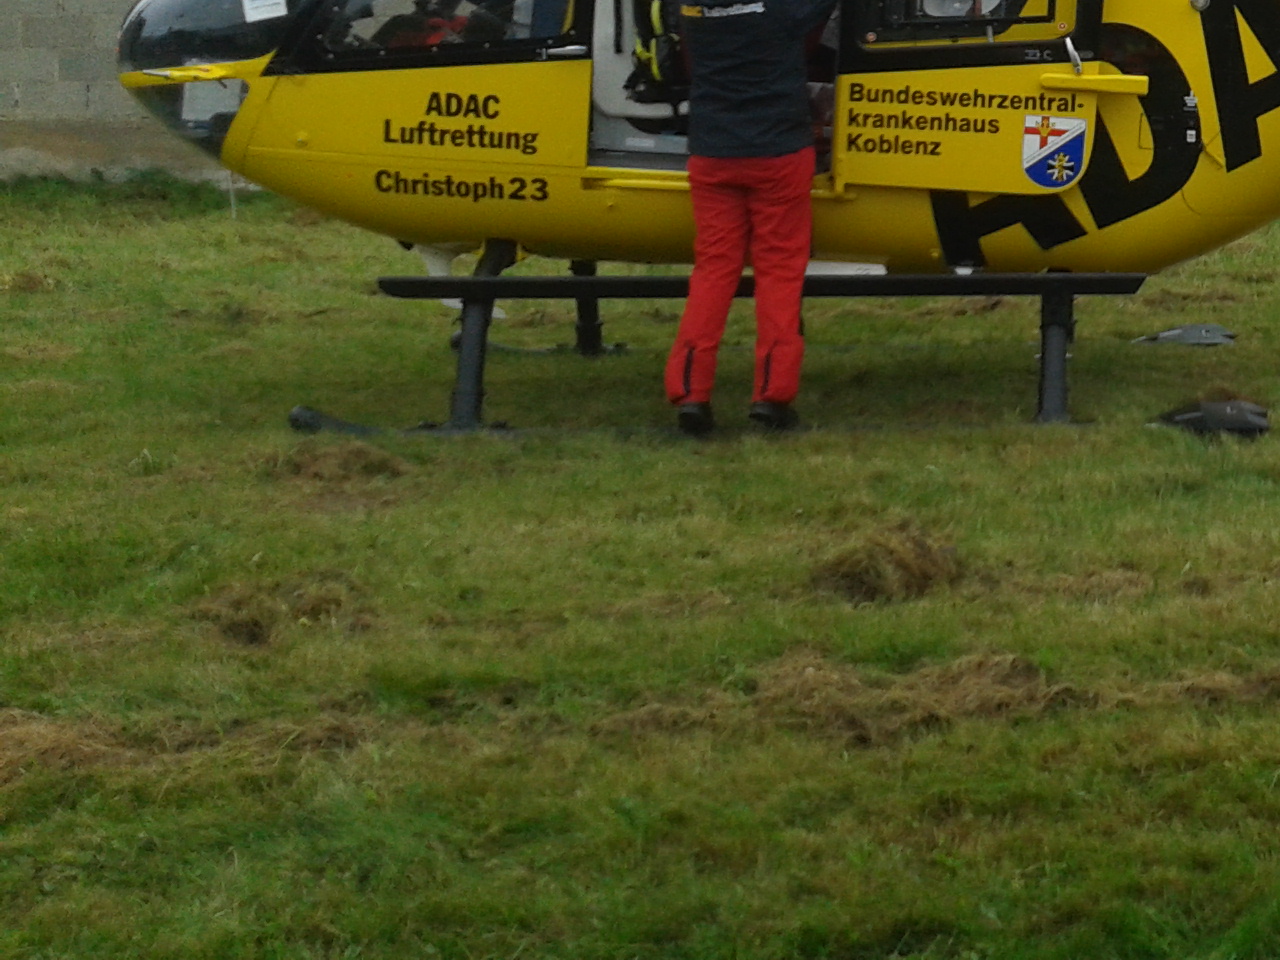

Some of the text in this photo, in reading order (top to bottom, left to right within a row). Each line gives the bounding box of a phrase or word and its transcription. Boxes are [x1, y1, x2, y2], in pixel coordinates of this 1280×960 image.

[425, 91, 500, 118] ADAC
[847, 109, 1001, 134] krankenhaus
[383, 118, 539, 155] Luftrettung
[846, 132, 942, 156] Koblenz
